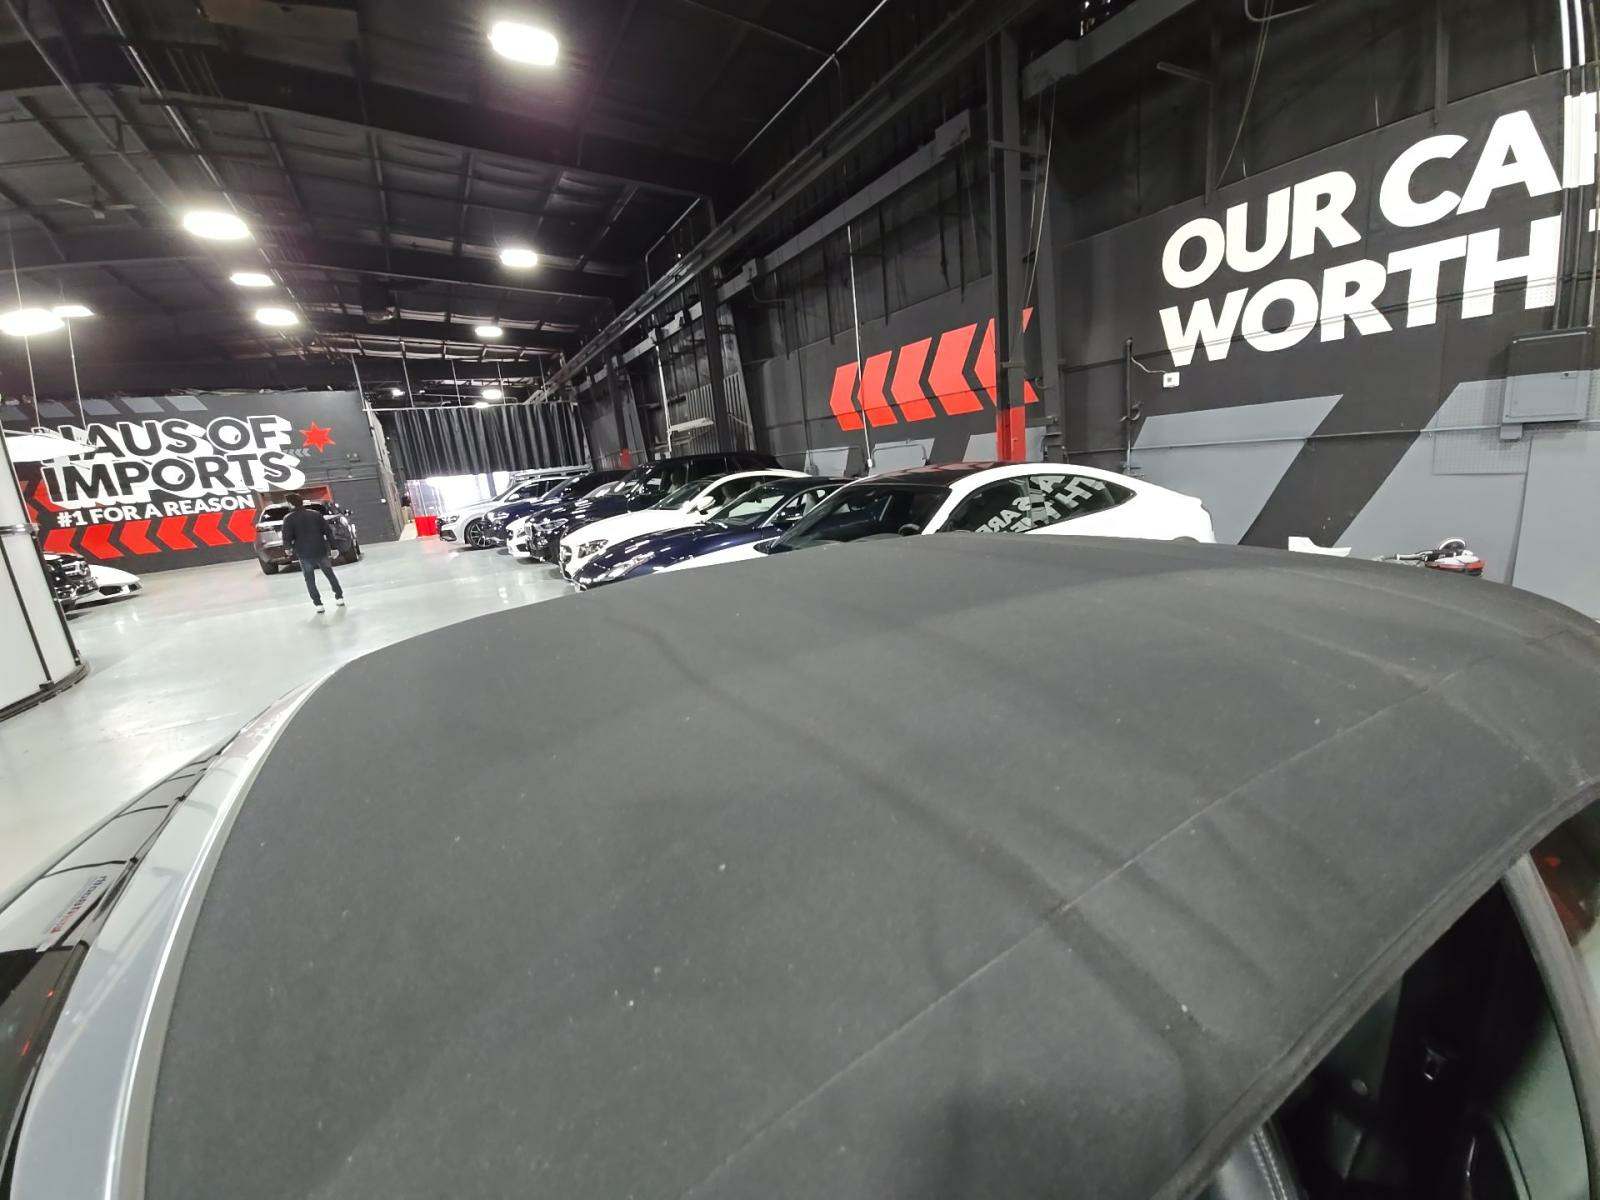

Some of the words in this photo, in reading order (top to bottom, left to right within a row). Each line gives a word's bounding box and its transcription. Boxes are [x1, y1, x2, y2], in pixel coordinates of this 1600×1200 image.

[1162, 170, 1361, 289] OUR
[1159, 215, 1562, 367] WORTH
[205, 415, 293, 453] OF
[41, 450, 306, 508] IMPORTS
[56, 509, 88, 528] #1
[89, 505, 138, 524] FOR
[144, 503, 164, 518] A
[163, 494, 256, 517] REASON
